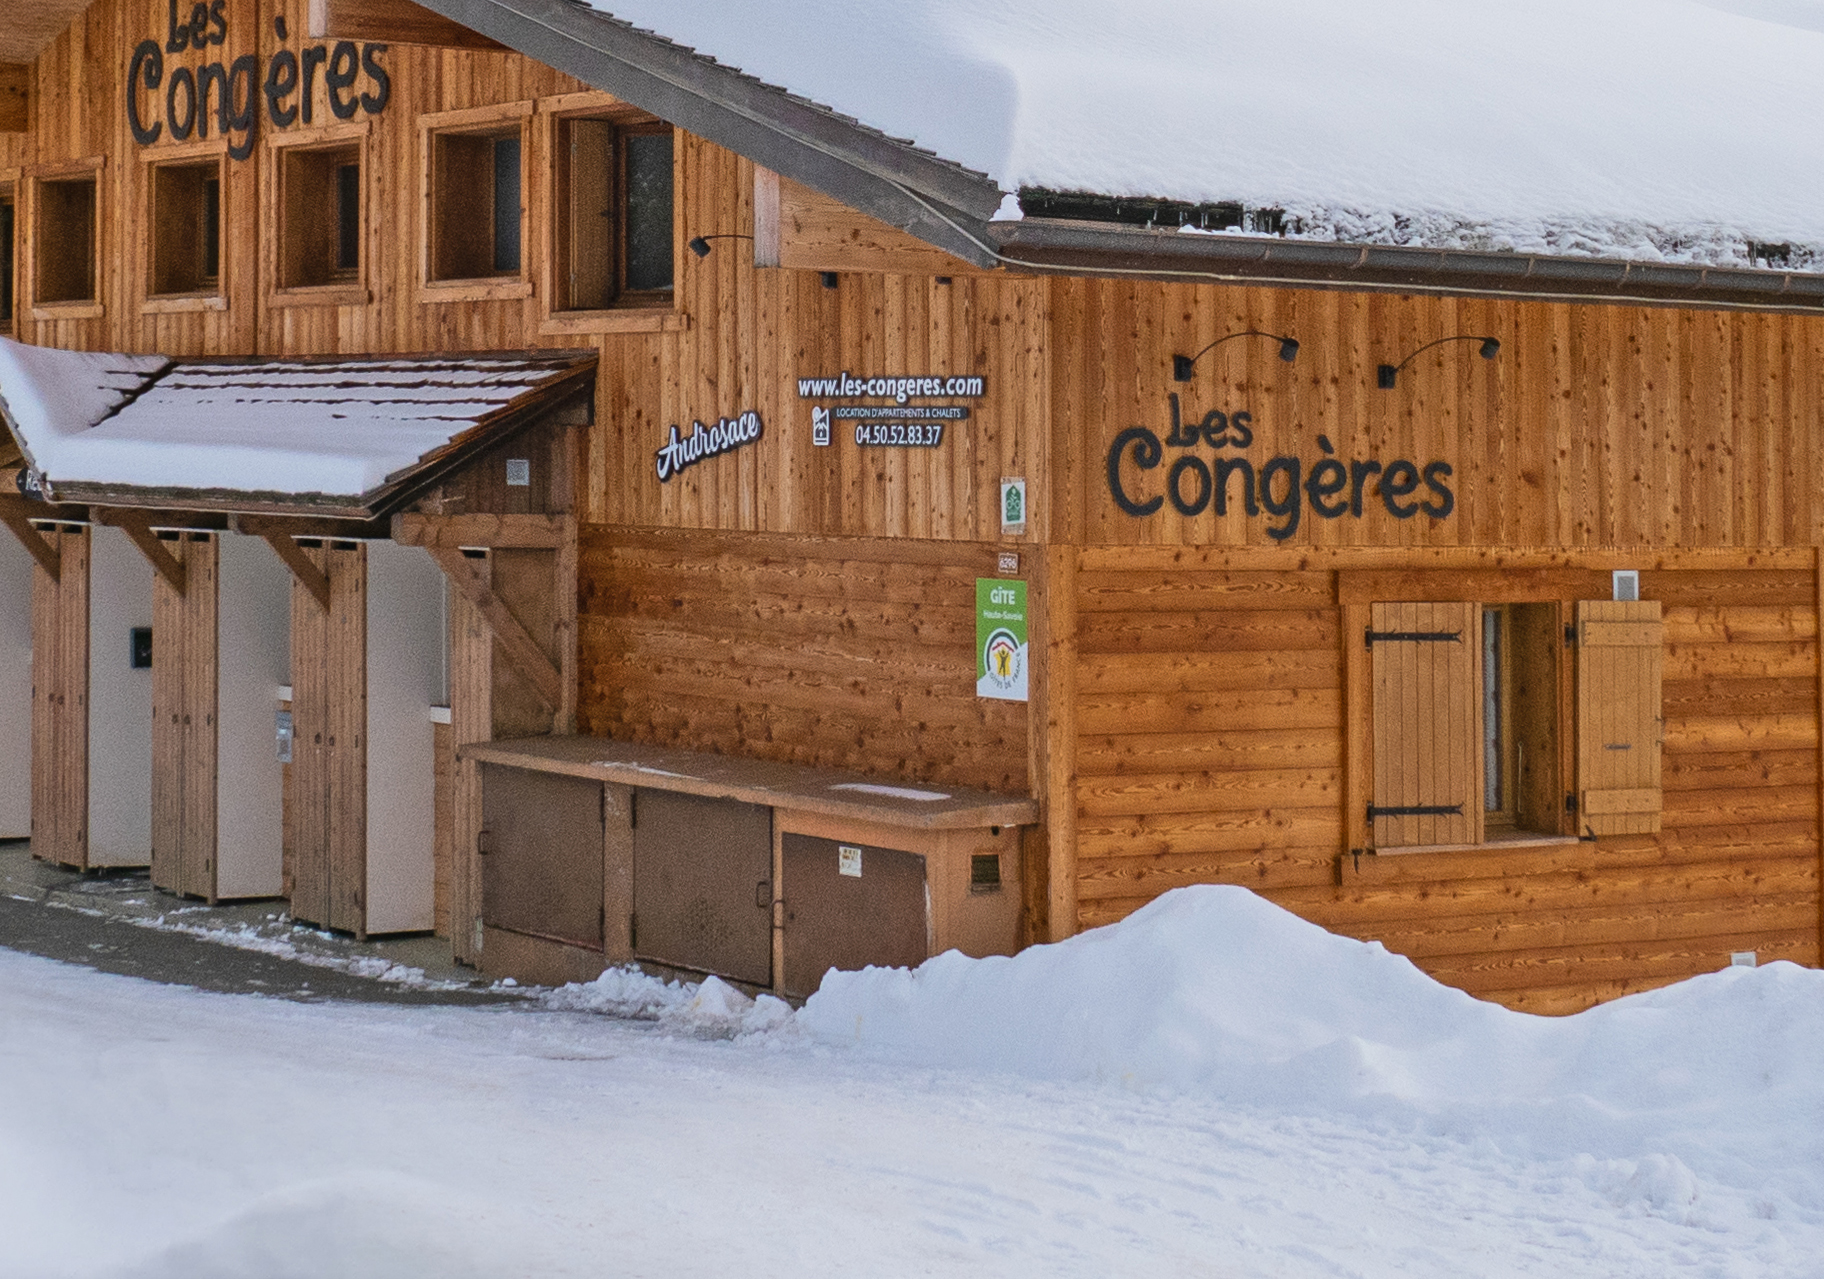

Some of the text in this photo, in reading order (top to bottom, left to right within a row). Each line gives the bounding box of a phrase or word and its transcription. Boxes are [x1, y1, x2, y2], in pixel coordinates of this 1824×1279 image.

[127, 16, 390, 160] Congères
[798, 372, 983, 403] www.les-congeres.com
[836, 407, 870, 418] LOCATION
[871, 407, 925, 418] D'APPARTEMENTS
[931, 408, 961, 418] CHALETS
[1166, 392, 1253, 449] Les
[657, 412, 760, 479] Androsace
[855, 425, 941, 445] 04.50.52.83.37
[1107, 427, 1454, 540] Congères
[990, 586, 1015, 605] GÎTE
